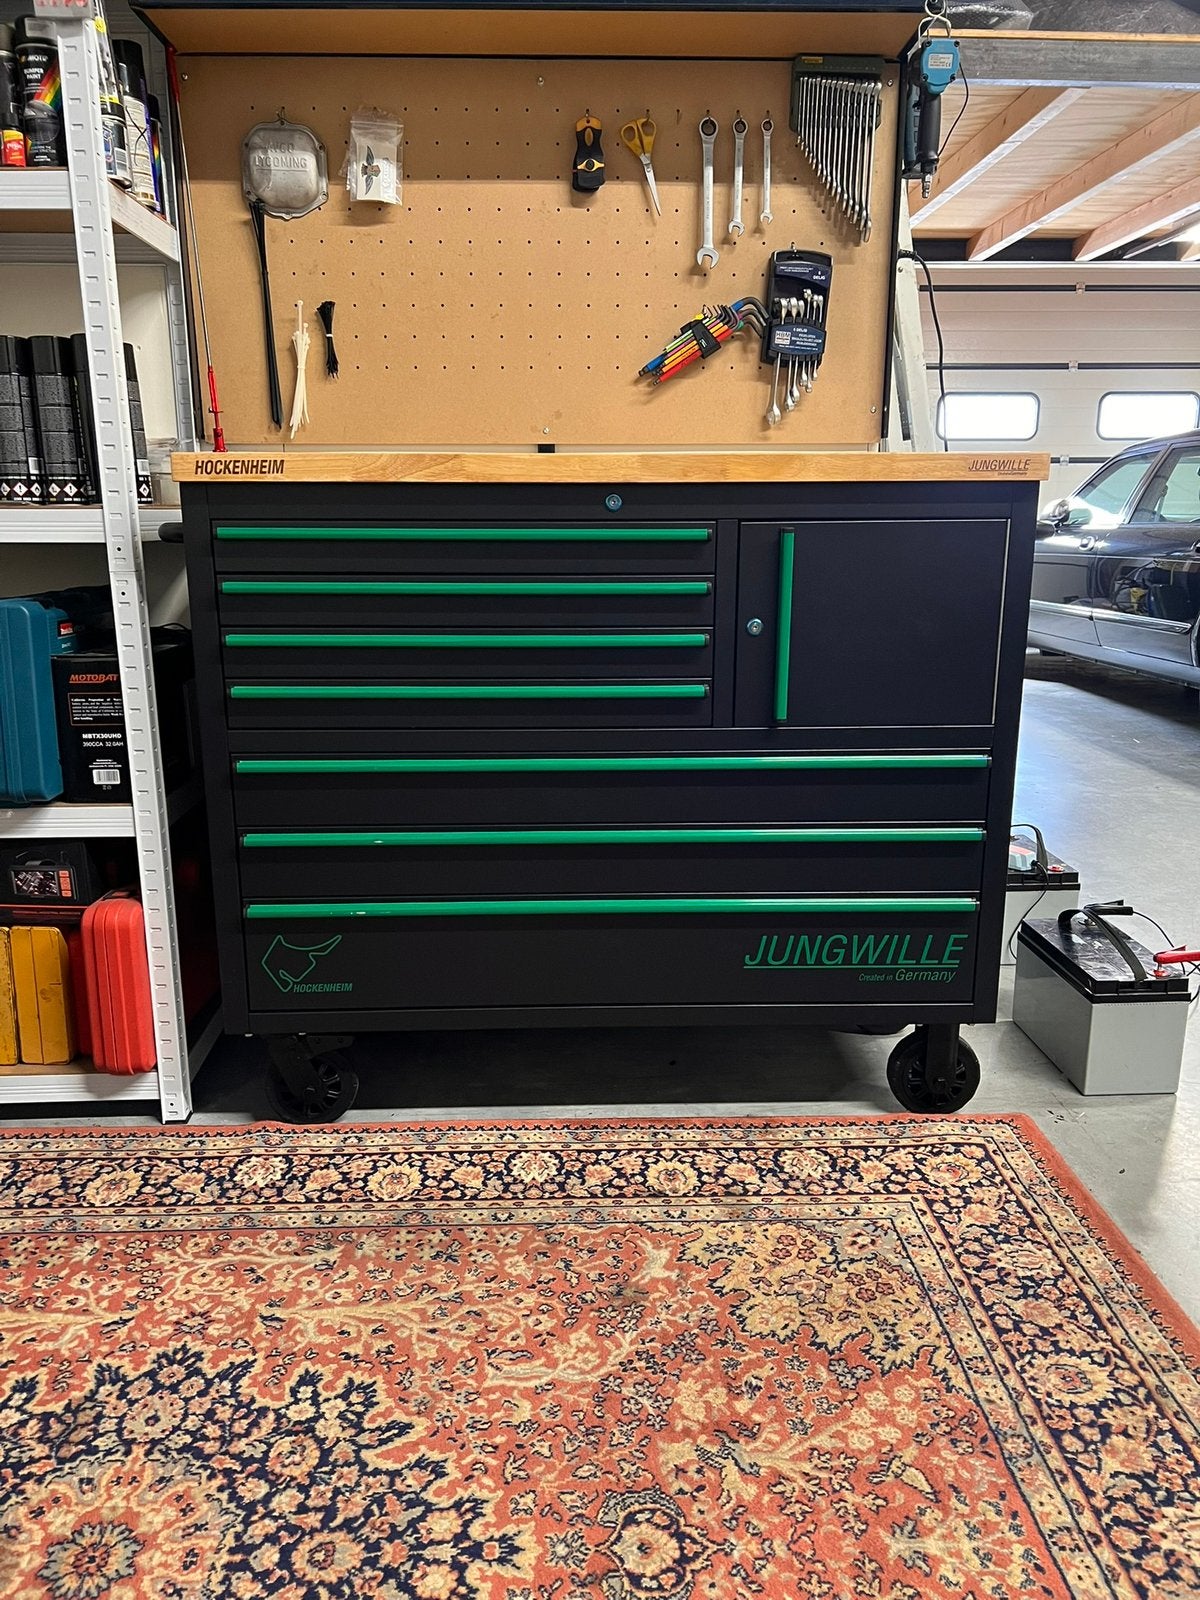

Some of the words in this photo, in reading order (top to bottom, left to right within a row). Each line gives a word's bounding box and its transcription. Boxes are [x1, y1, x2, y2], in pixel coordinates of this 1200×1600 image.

[255, 155, 308, 169] LYCOMING
[194, 459, 285, 476] HOCKENHEIM
[968, 459, 1032, 471] JUNGWILLE
[69, 673, 119, 684] MOTOBAT
[744, 934, 969, 966] JUNGWILLE
[858, 973, 886, 982] Created
[895, 969, 957, 983] Germany
[293, 982, 353, 993] HOCKENHEIM
